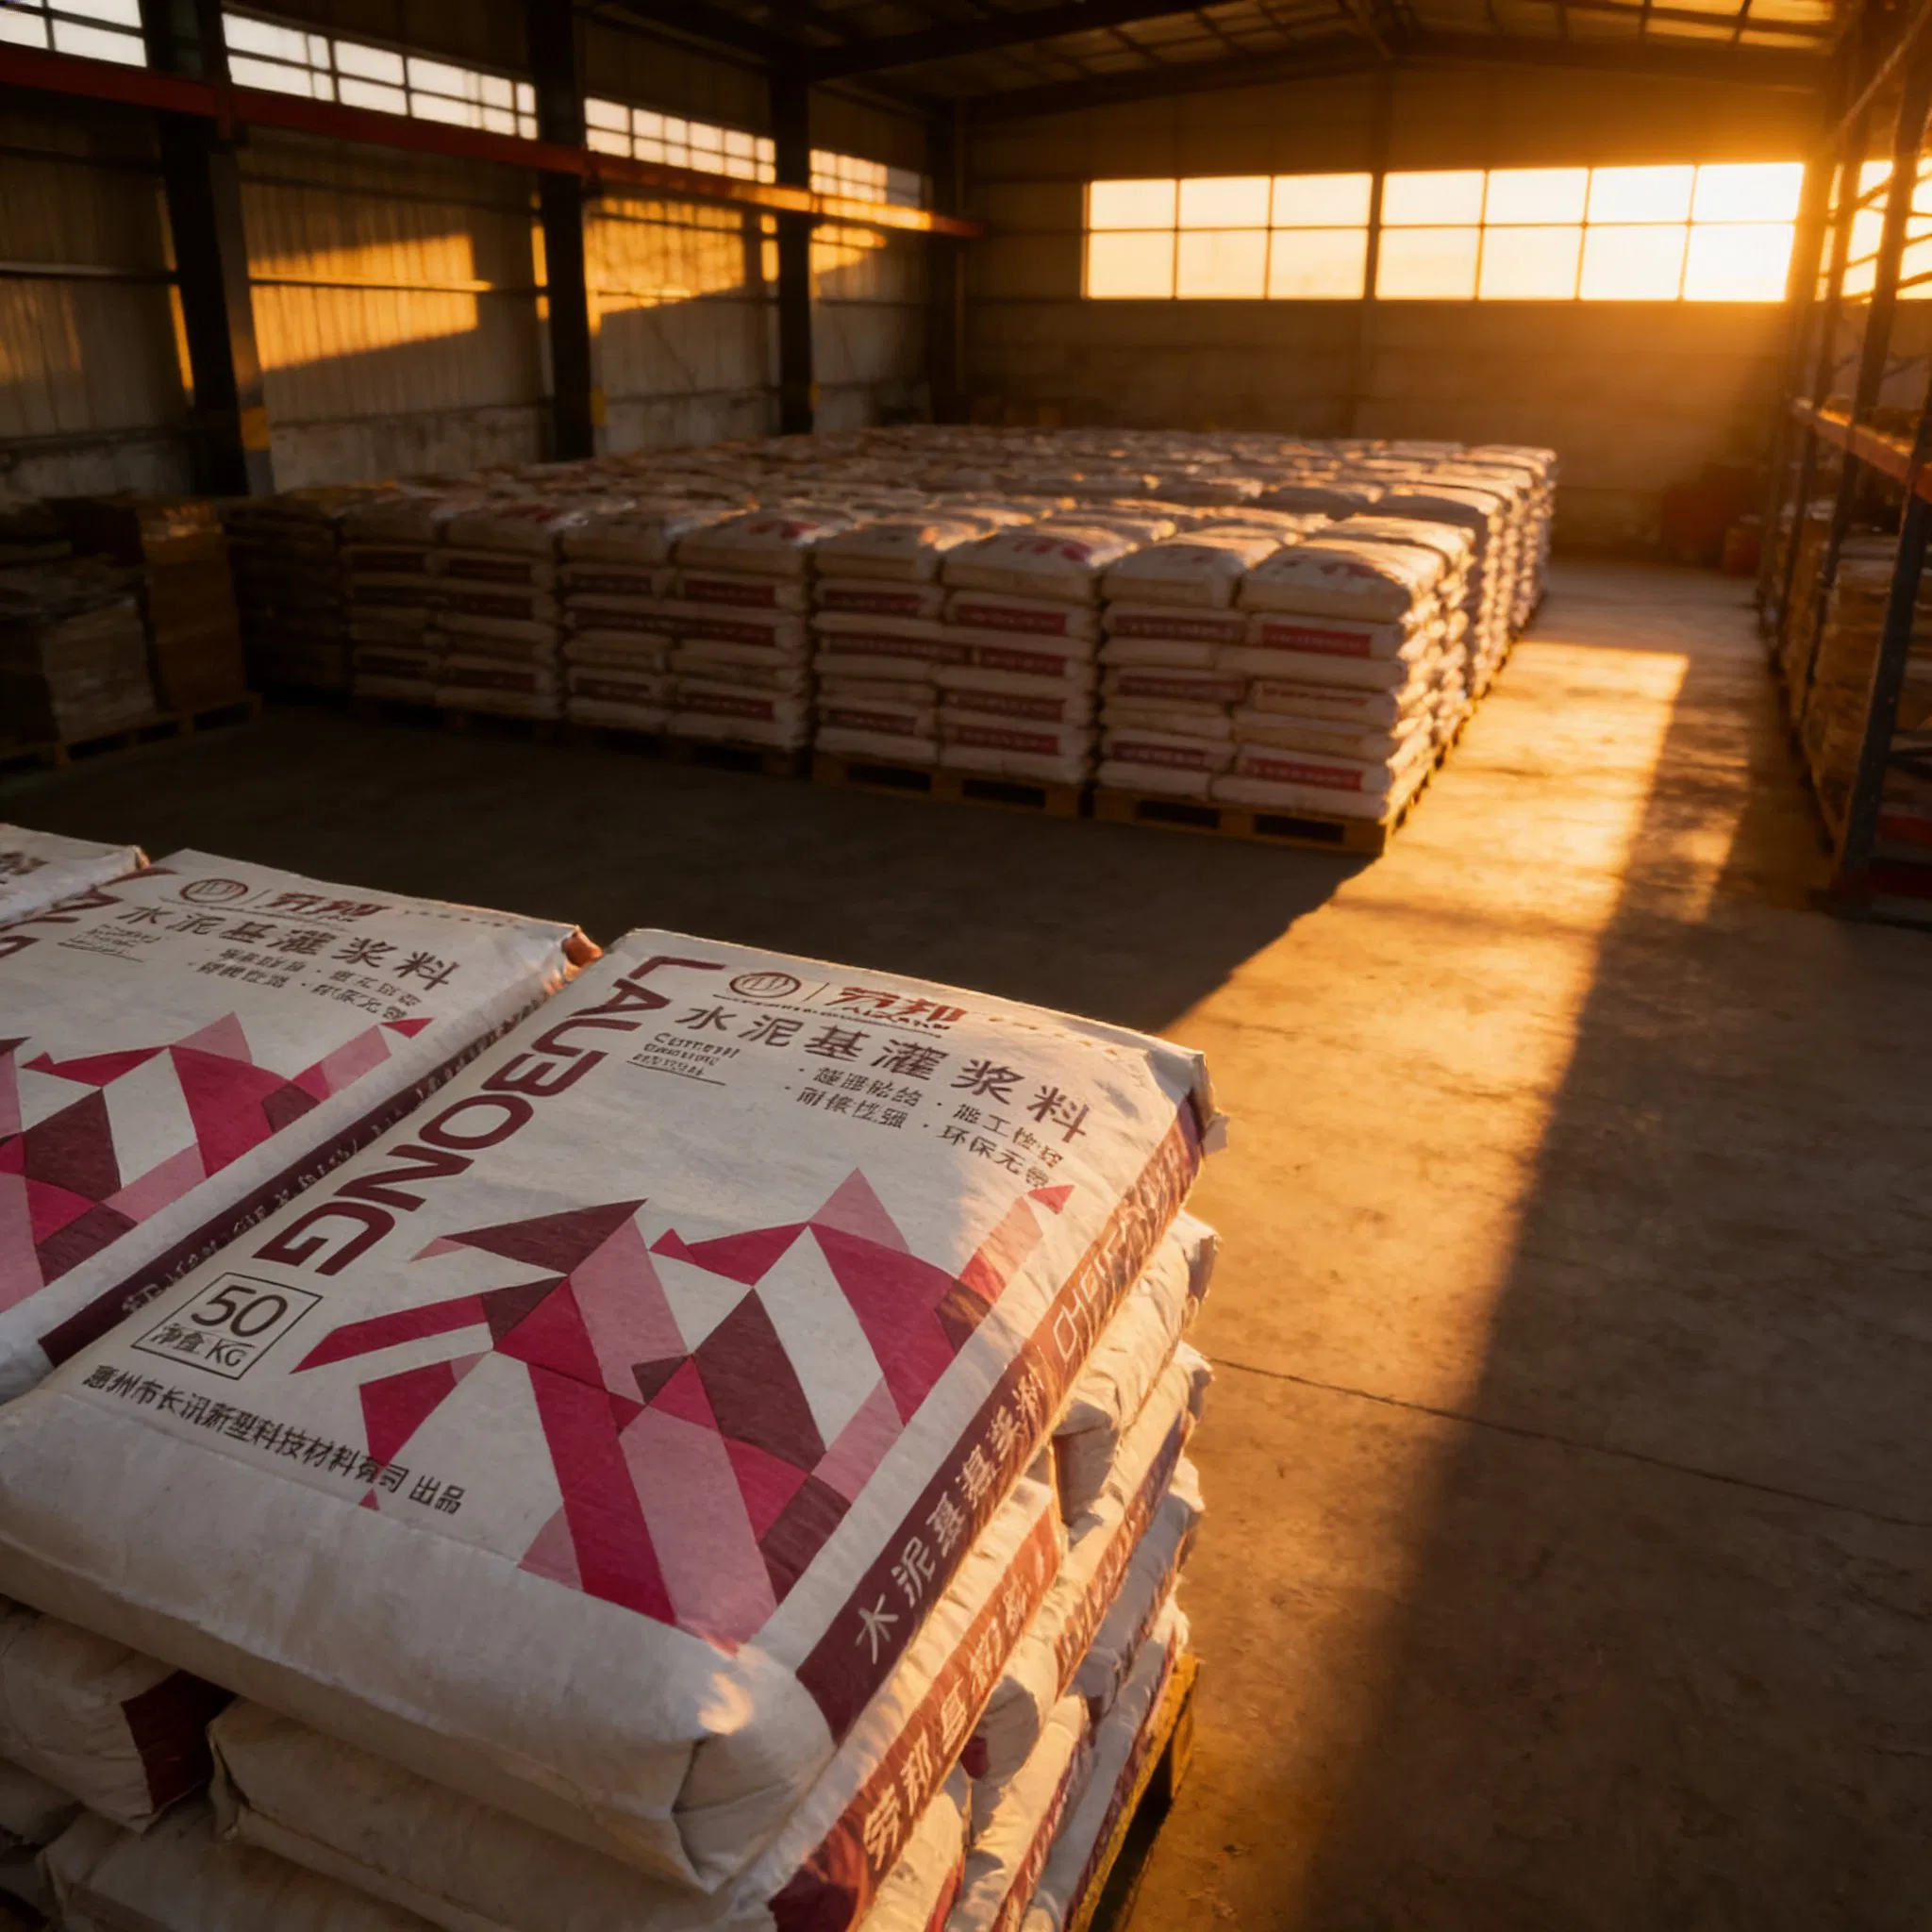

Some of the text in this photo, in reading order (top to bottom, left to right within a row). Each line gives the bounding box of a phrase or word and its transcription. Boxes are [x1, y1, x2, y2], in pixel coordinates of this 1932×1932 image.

[251, 955, 726, 1276] LAUBONG
[675, 1005, 1091, 1143] 水泥基灌浆料
[191, 1284, 288, 1338] 50
